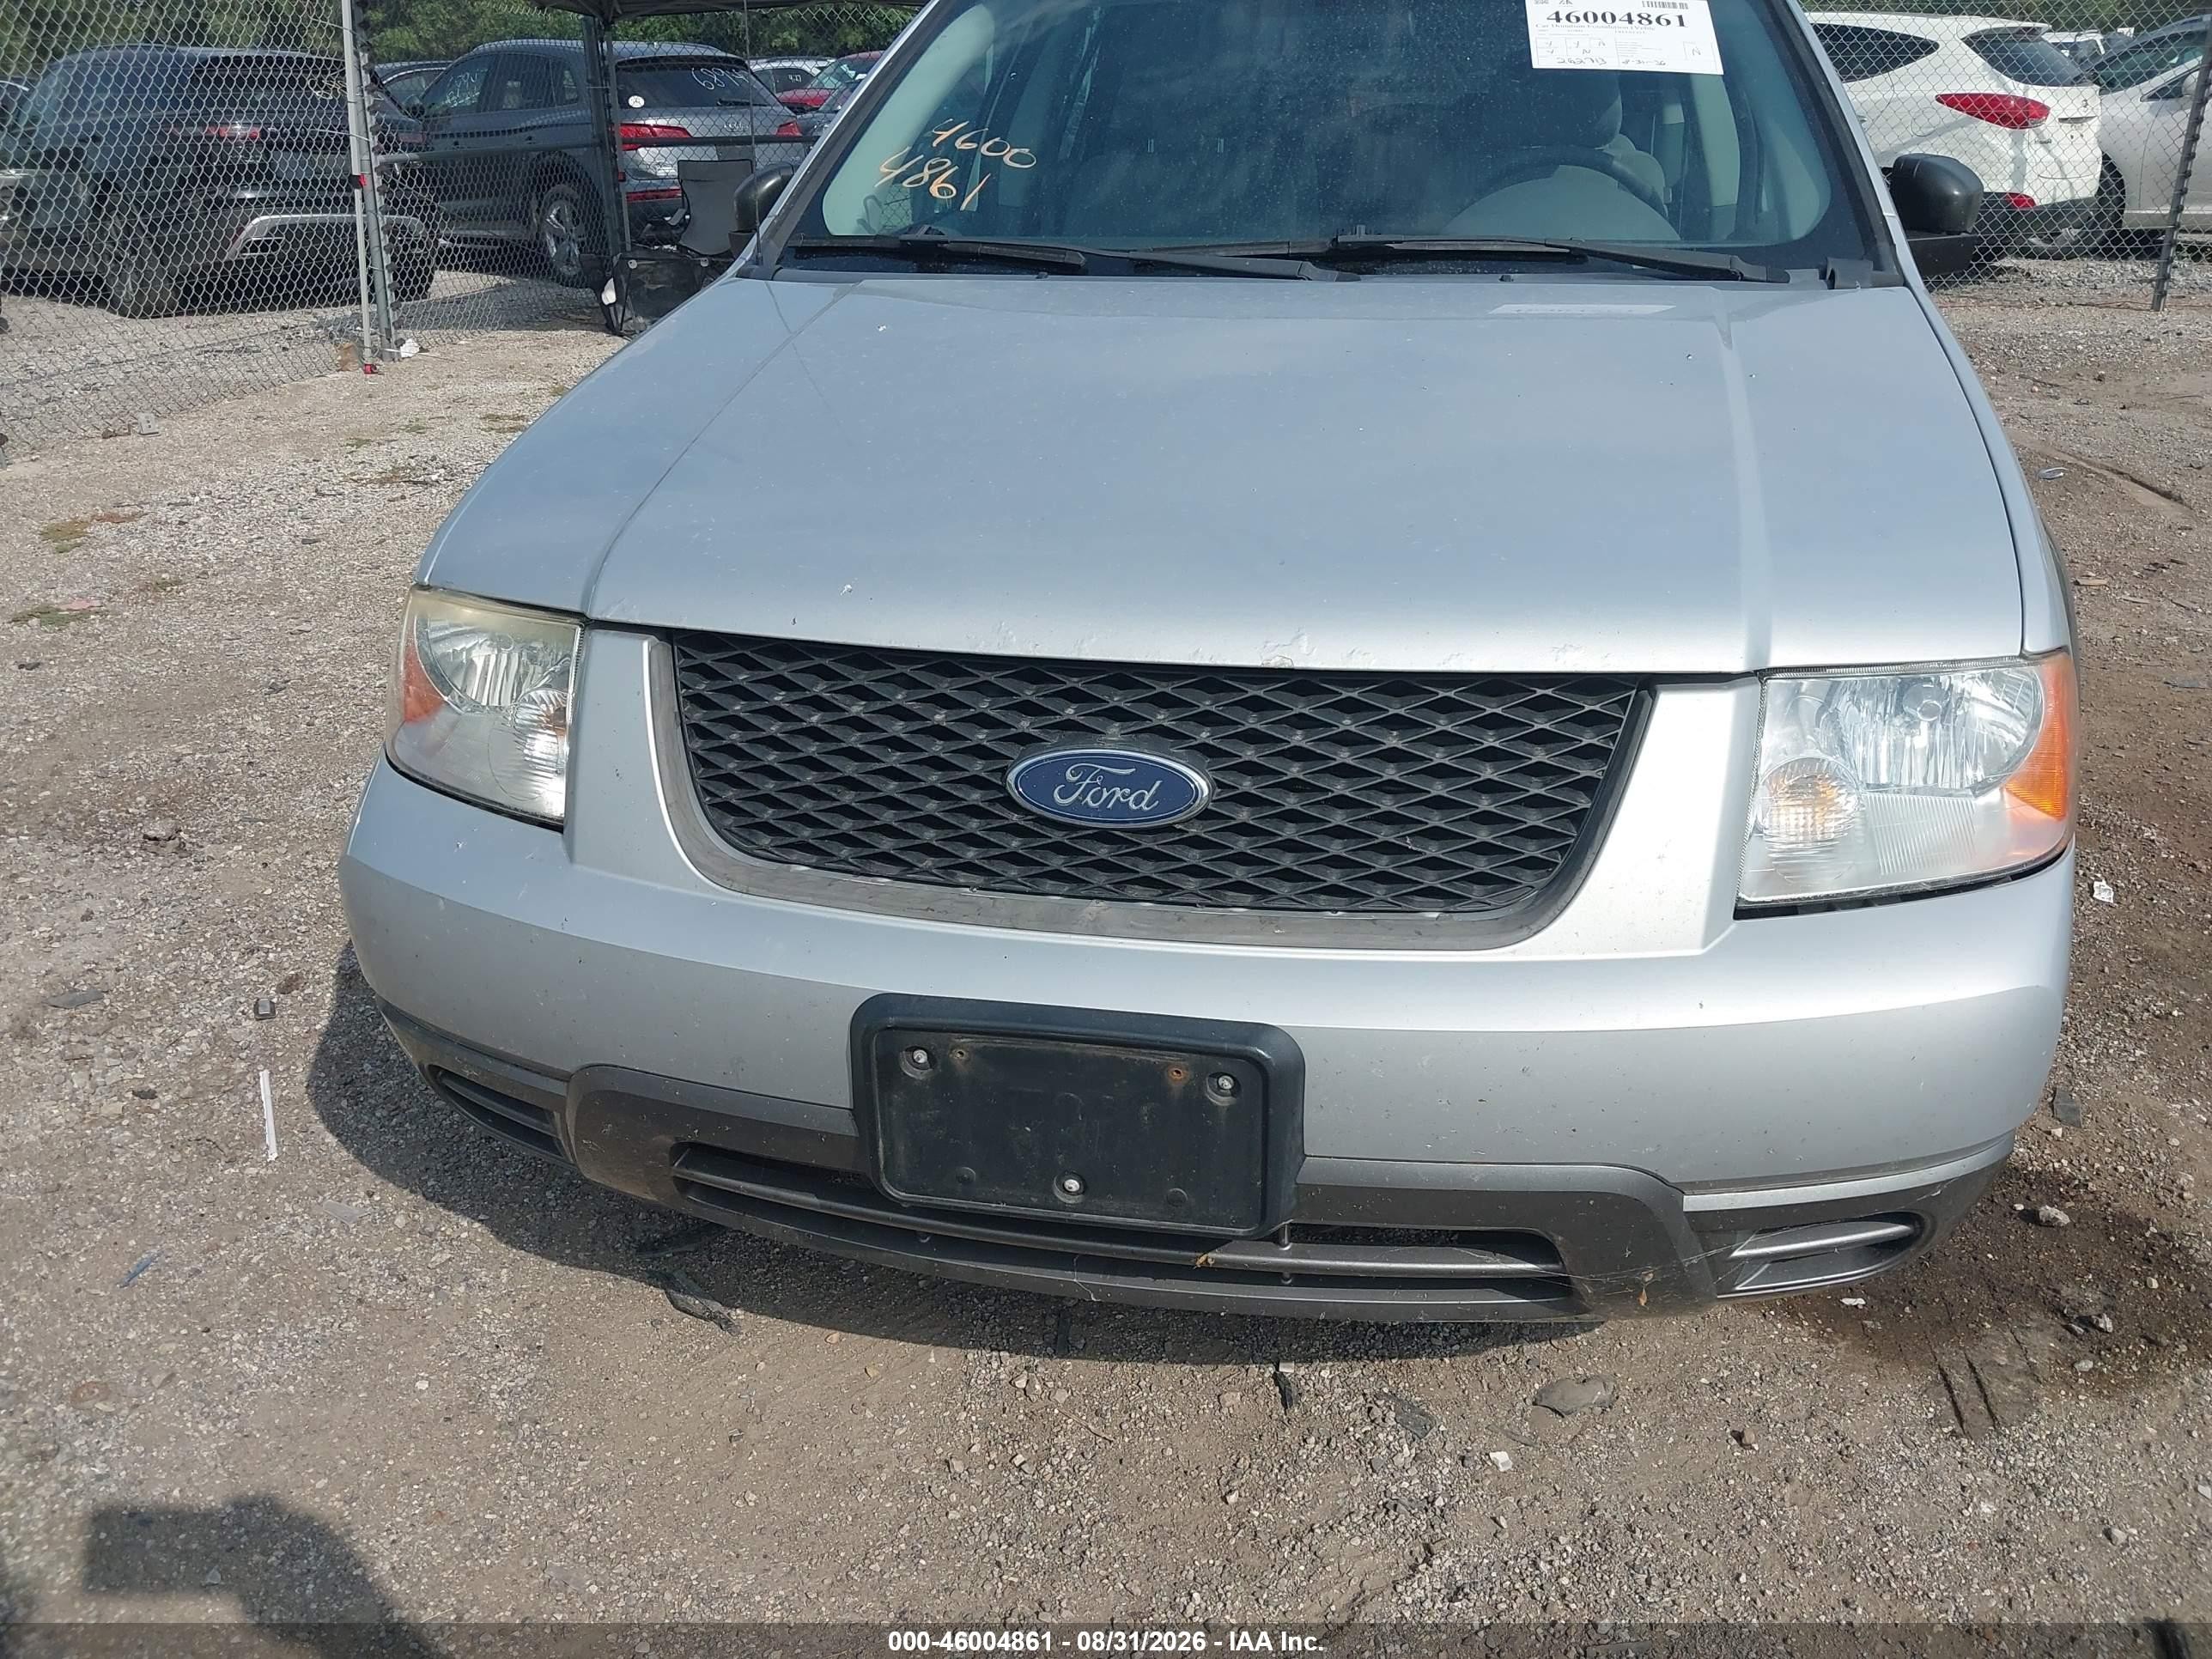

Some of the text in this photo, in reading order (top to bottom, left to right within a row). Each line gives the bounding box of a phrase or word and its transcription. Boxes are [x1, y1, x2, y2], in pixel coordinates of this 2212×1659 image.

[1547, 10, 1689, 27] 46004861
[932, 118, 1037, 168] 4600
[873, 145, 992, 211] 4861
[1053, 762, 1163, 811] Ford
